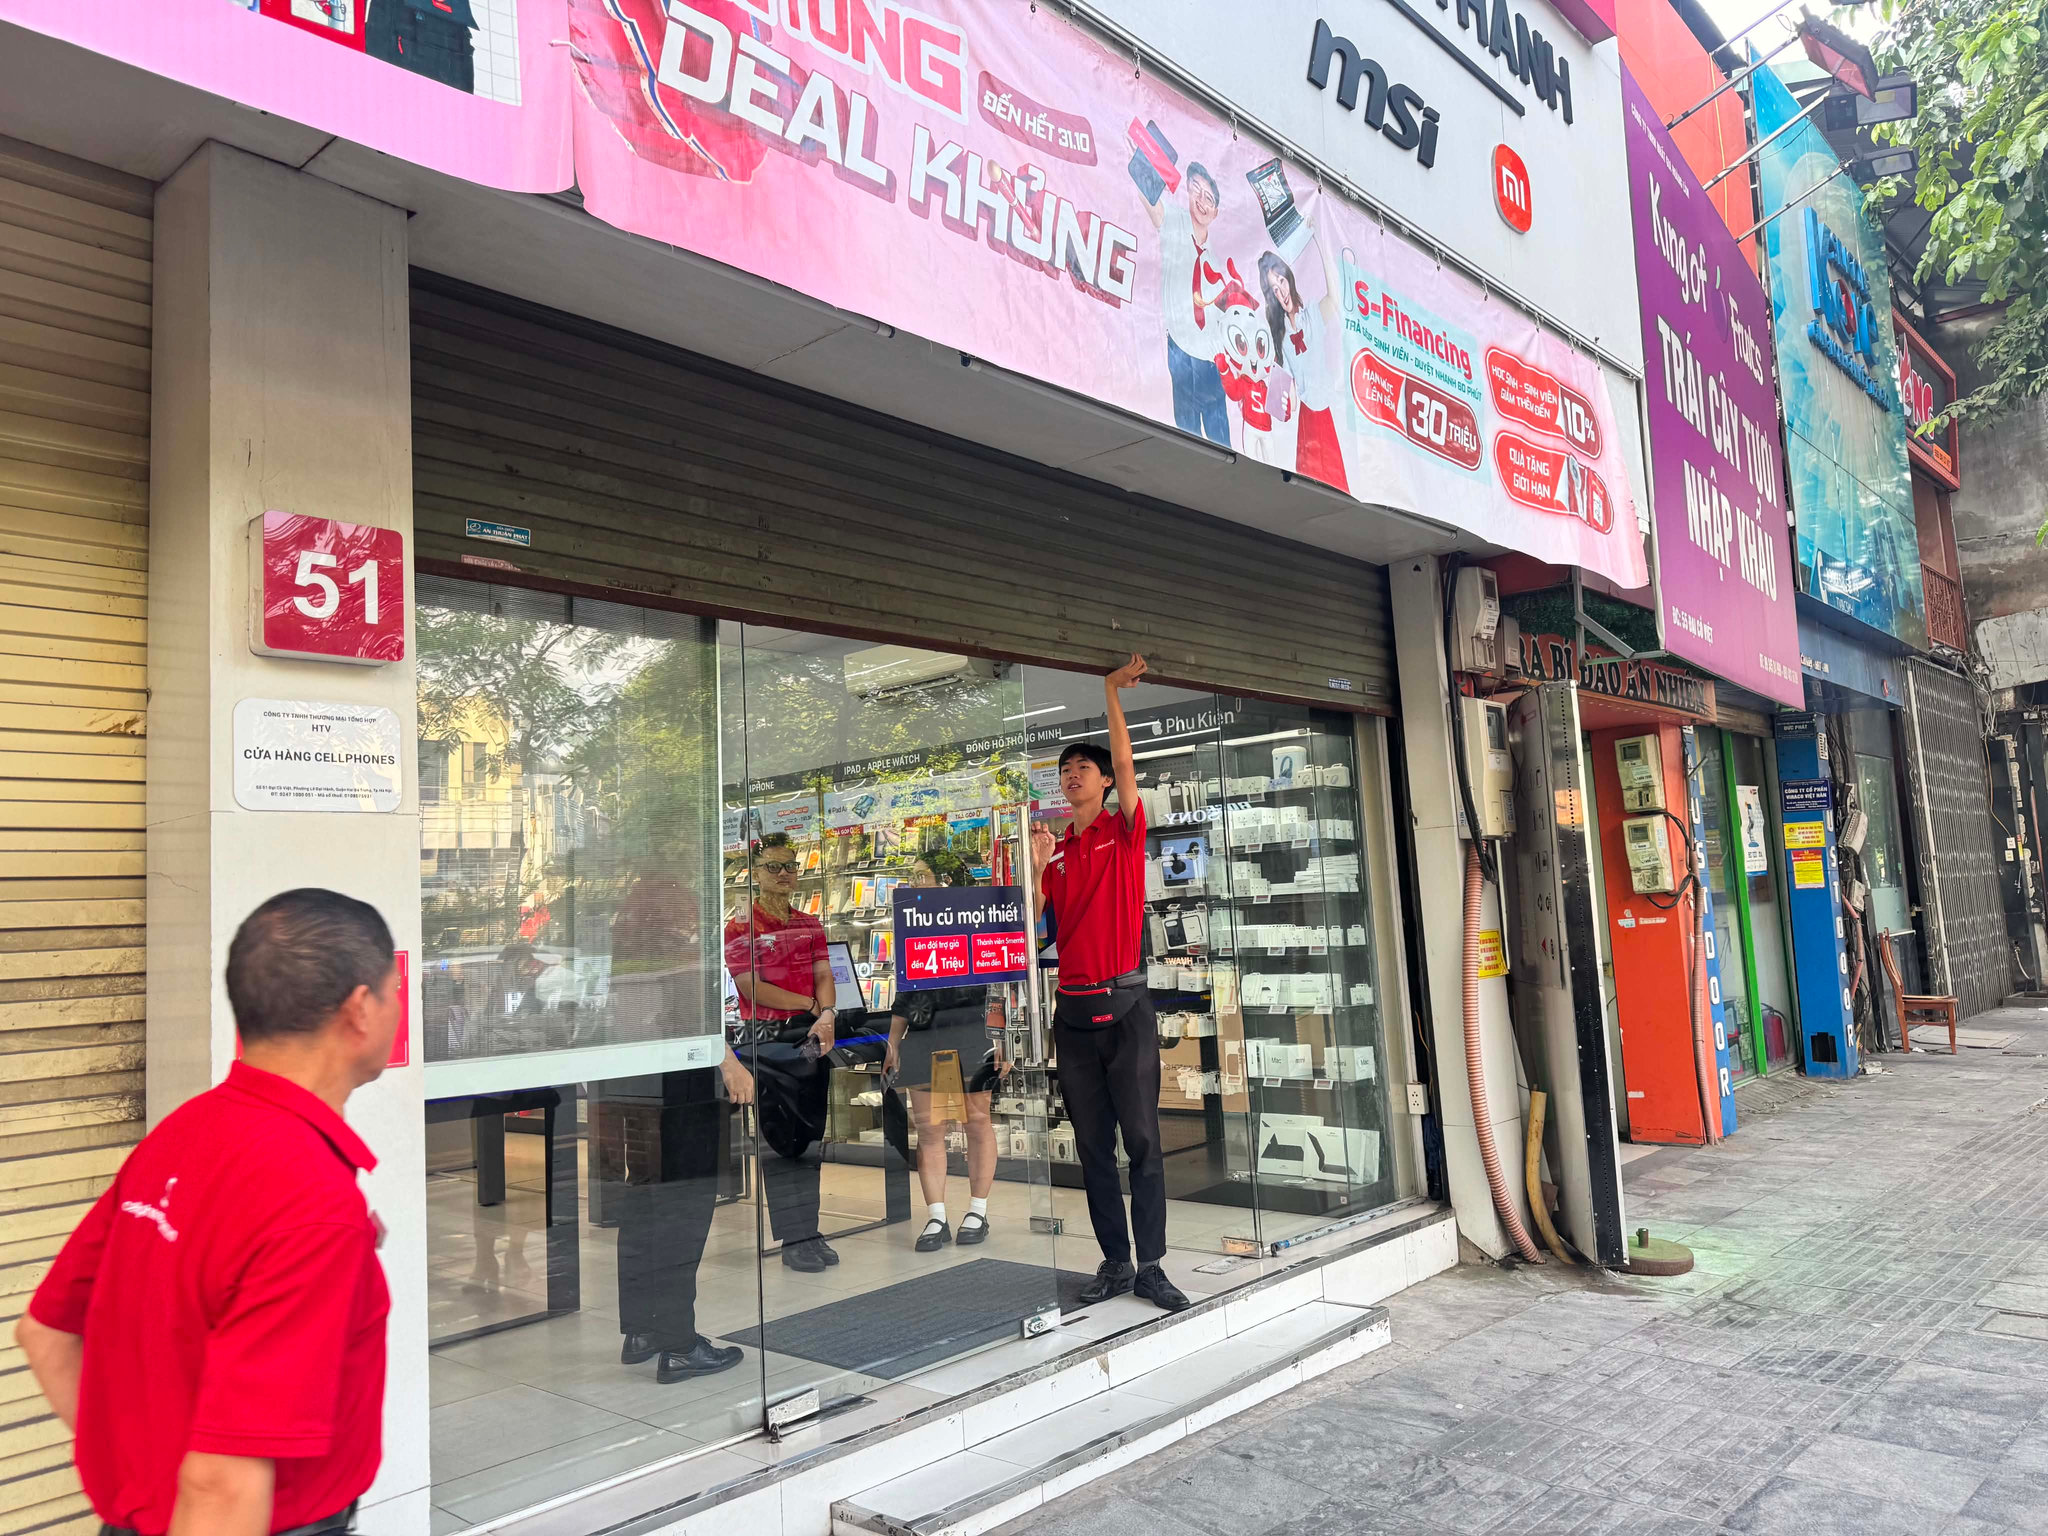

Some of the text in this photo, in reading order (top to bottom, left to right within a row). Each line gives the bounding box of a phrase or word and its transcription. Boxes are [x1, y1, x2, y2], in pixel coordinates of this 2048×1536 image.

[1307, 18, 1440, 168] msi
[982, 90, 1091, 154] ĐẾN HẾT 31.10
[657, 0, 1138, 304] DEAL KHỦNG
[1649, 171, 1689, 305] King
[1690, 242, 1708, 314] of
[1354, 280, 1473, 382] S-Financing
[1728, 291, 1764, 386] Fruits
[1373, 336, 1391, 354] SINH
[1391, 346, 1409, 363] VIÊN
[1414, 357, 1435, 377] DUYỆT
[1365, 386, 1383, 404] LÊN
[1524, 383, 1539, 399] SINH
[1540, 389, 1558, 405] VIÊN
[1411, 391, 1477, 453] 30 TRIỆU
[1534, 402, 1550, 420] ĐẾN
[1657, 314, 1778, 509] TRÁI CÂY TƯƠI
[1509, 447, 1550, 477] QUÀ TẶNG
[1531, 481, 1550, 500] HẠN
[1683, 459, 1778, 602] NHẬP KHẨU
[293, 550, 380, 625] 51
[311, 724, 332, 733] HTV
[1036, 728, 1062, 743] MINH
[243, 746, 395, 765] CỬA HÀNG CELLPHONES
[842, 763, 860, 776] IPAD
[867, 757, 890, 772] APPLE
[891, 752, 921, 768] WATCH
[749, 780, 775, 793] IPHONE
[903, 901, 1018, 929] Thu cũ mọi thiết
[914, 940, 960, 951] Lên đời trợ giá
[976, 938, 994, 946] Thành
[994, 937, 1005, 945] viên
[911, 950, 965, 974] đến 4 Triệu
[1000, 945, 1025, 969] 1 Triệ
